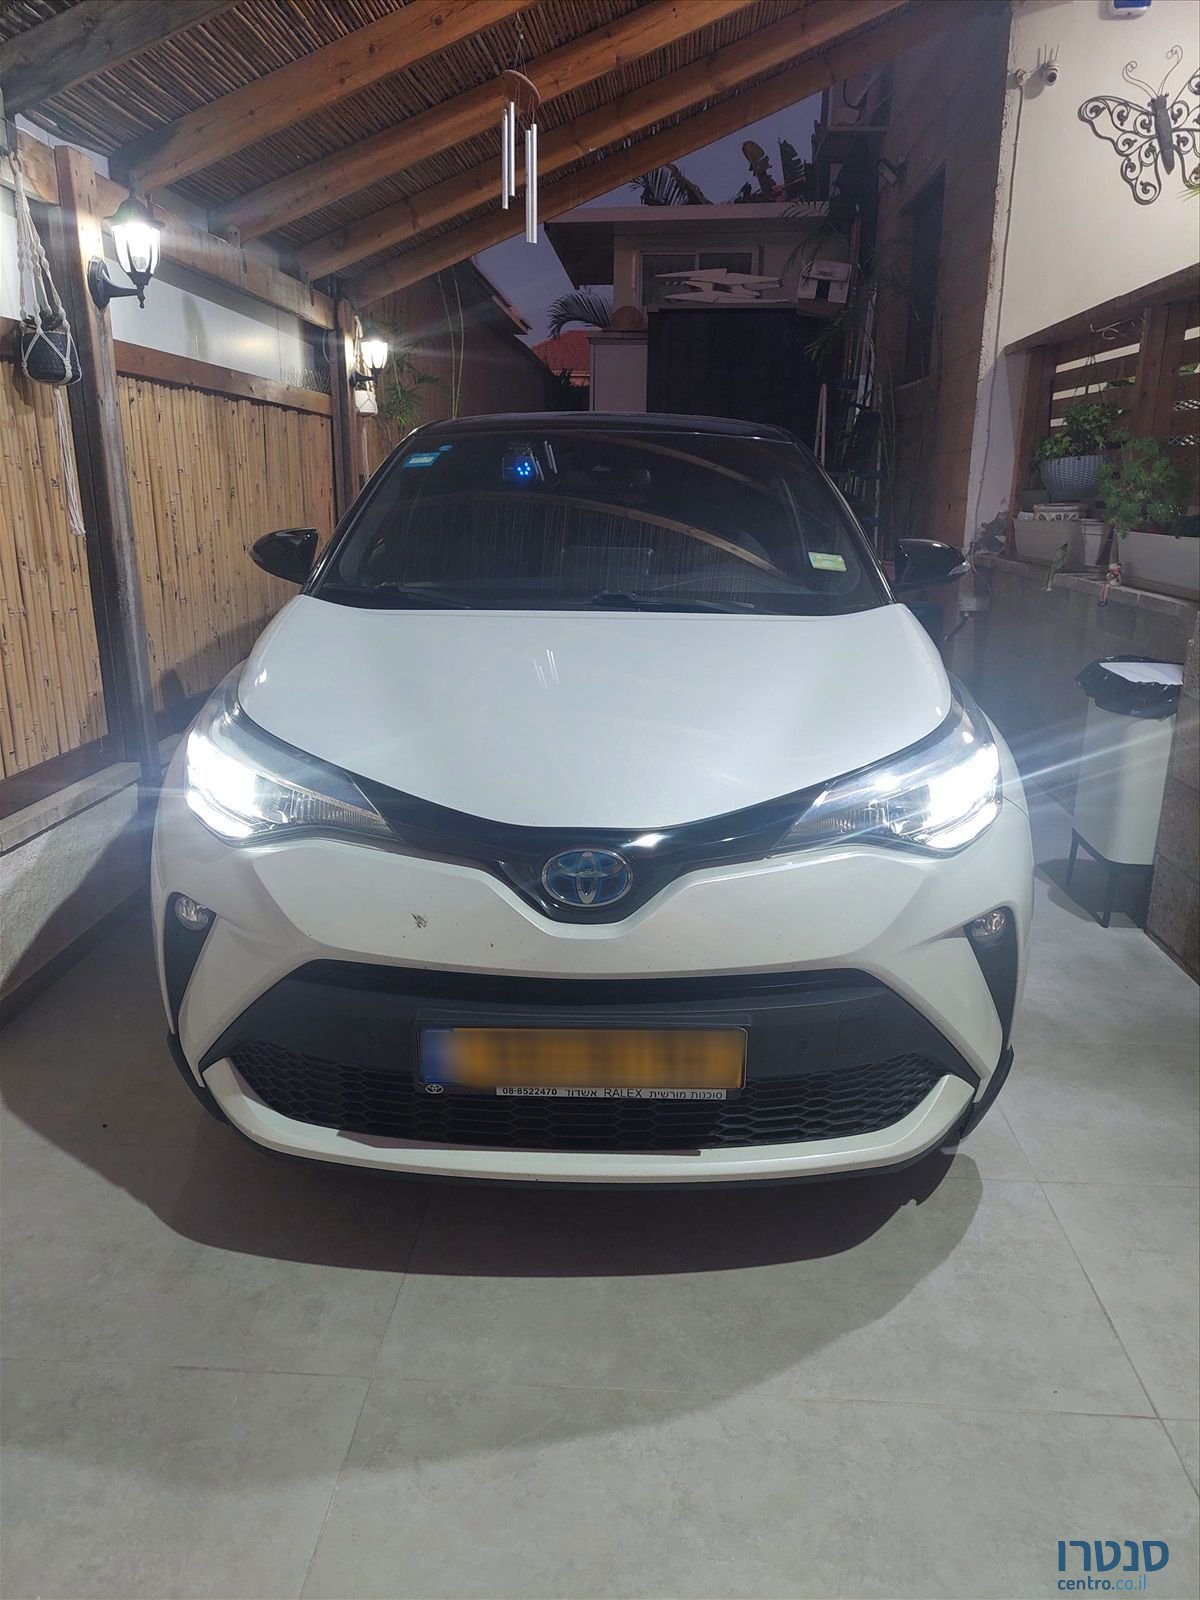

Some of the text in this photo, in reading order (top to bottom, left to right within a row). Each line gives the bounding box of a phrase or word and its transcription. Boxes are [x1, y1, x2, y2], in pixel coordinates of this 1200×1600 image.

[502, 1087, 723, 1099] סוכנות מורשית RALEX אשדוד 08-8522470
